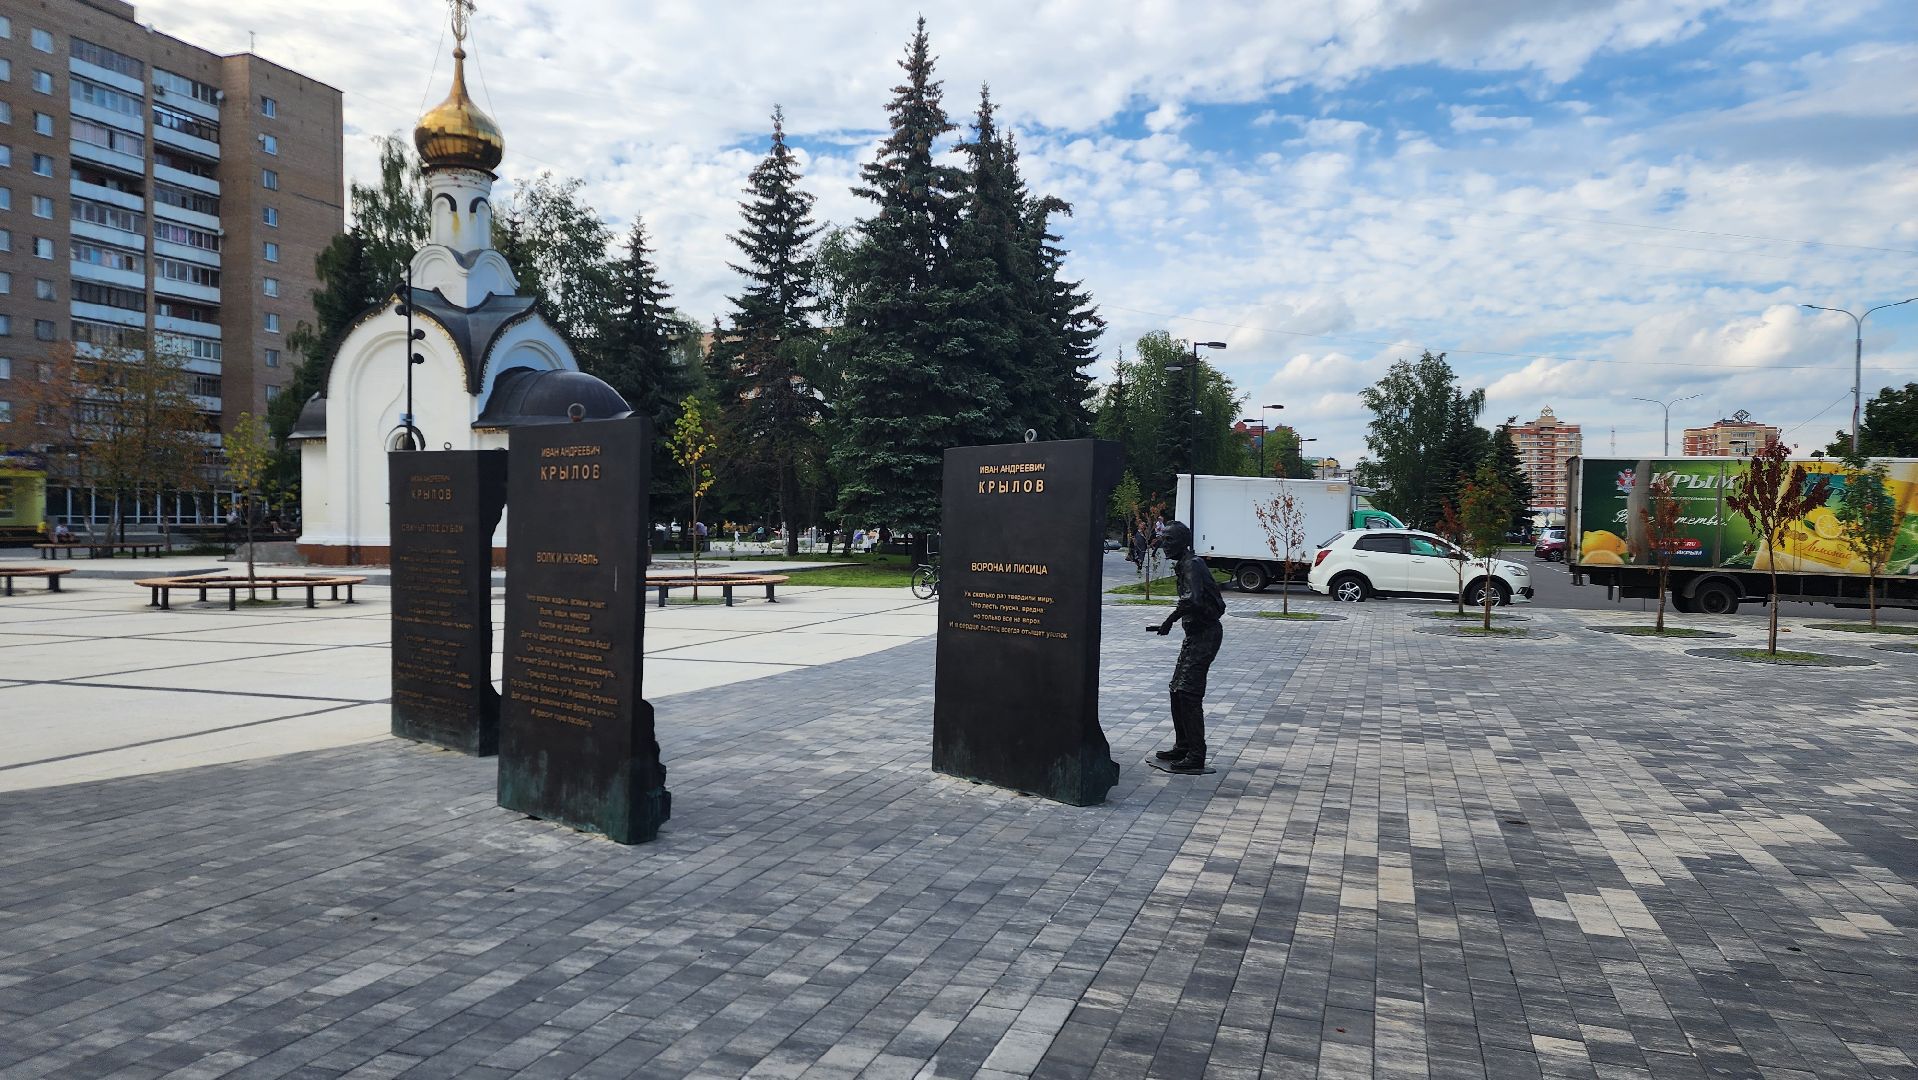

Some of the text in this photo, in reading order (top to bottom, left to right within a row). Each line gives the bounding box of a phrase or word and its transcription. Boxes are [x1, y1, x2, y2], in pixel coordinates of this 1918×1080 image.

[542, 446, 600, 457] ИВАН АНДРЕЕВИЧ
[540, 464, 600, 480] КРЫЛОВ
[980, 464, 1045, 474] ИВАН АНДРЕЕВИЧ
[979, 480, 1044, 493] КРЫЛОВ
[536, 552, 598, 564] ВОЛК И ЖУРАВЛЬ
[972, 563, 1047, 575] ВОРОНА И ЛИСИЦА
